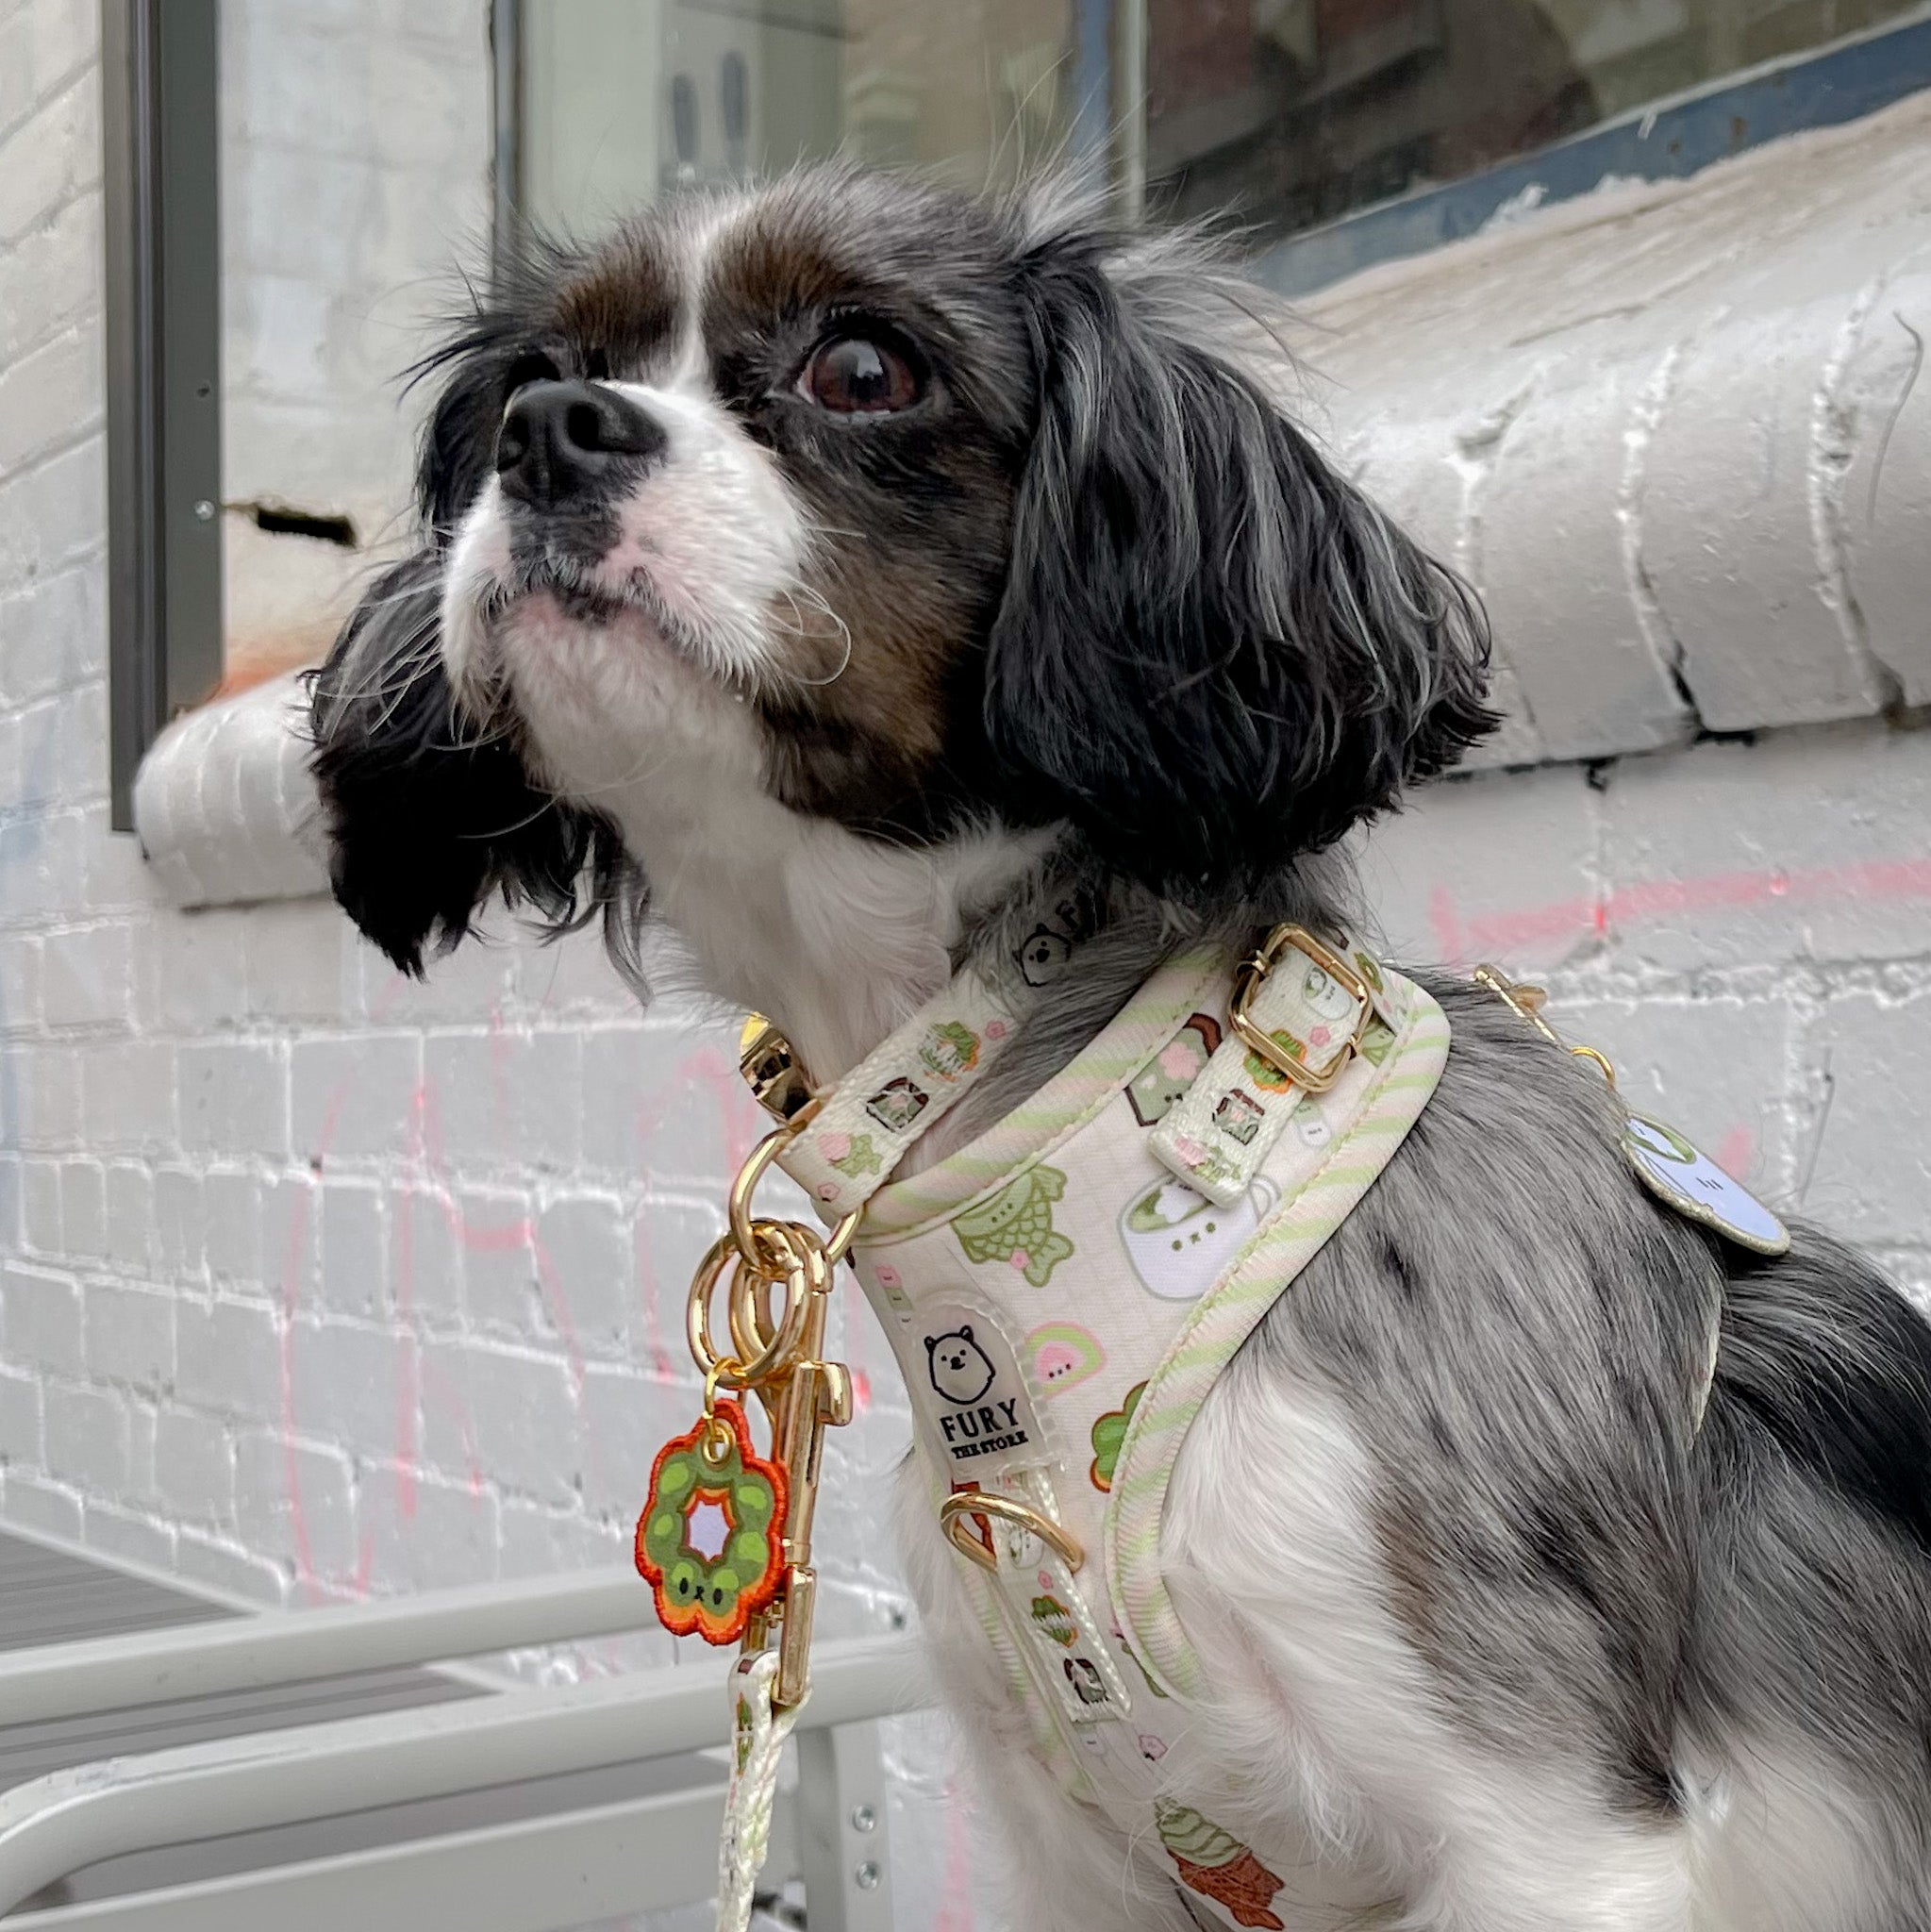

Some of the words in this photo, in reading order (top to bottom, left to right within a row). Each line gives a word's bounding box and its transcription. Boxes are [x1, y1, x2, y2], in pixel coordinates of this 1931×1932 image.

[941, 1398, 1019, 1441] FURY
[951, 1443, 981, 1459] THE
[980, 1430, 1029, 1455] STORE
